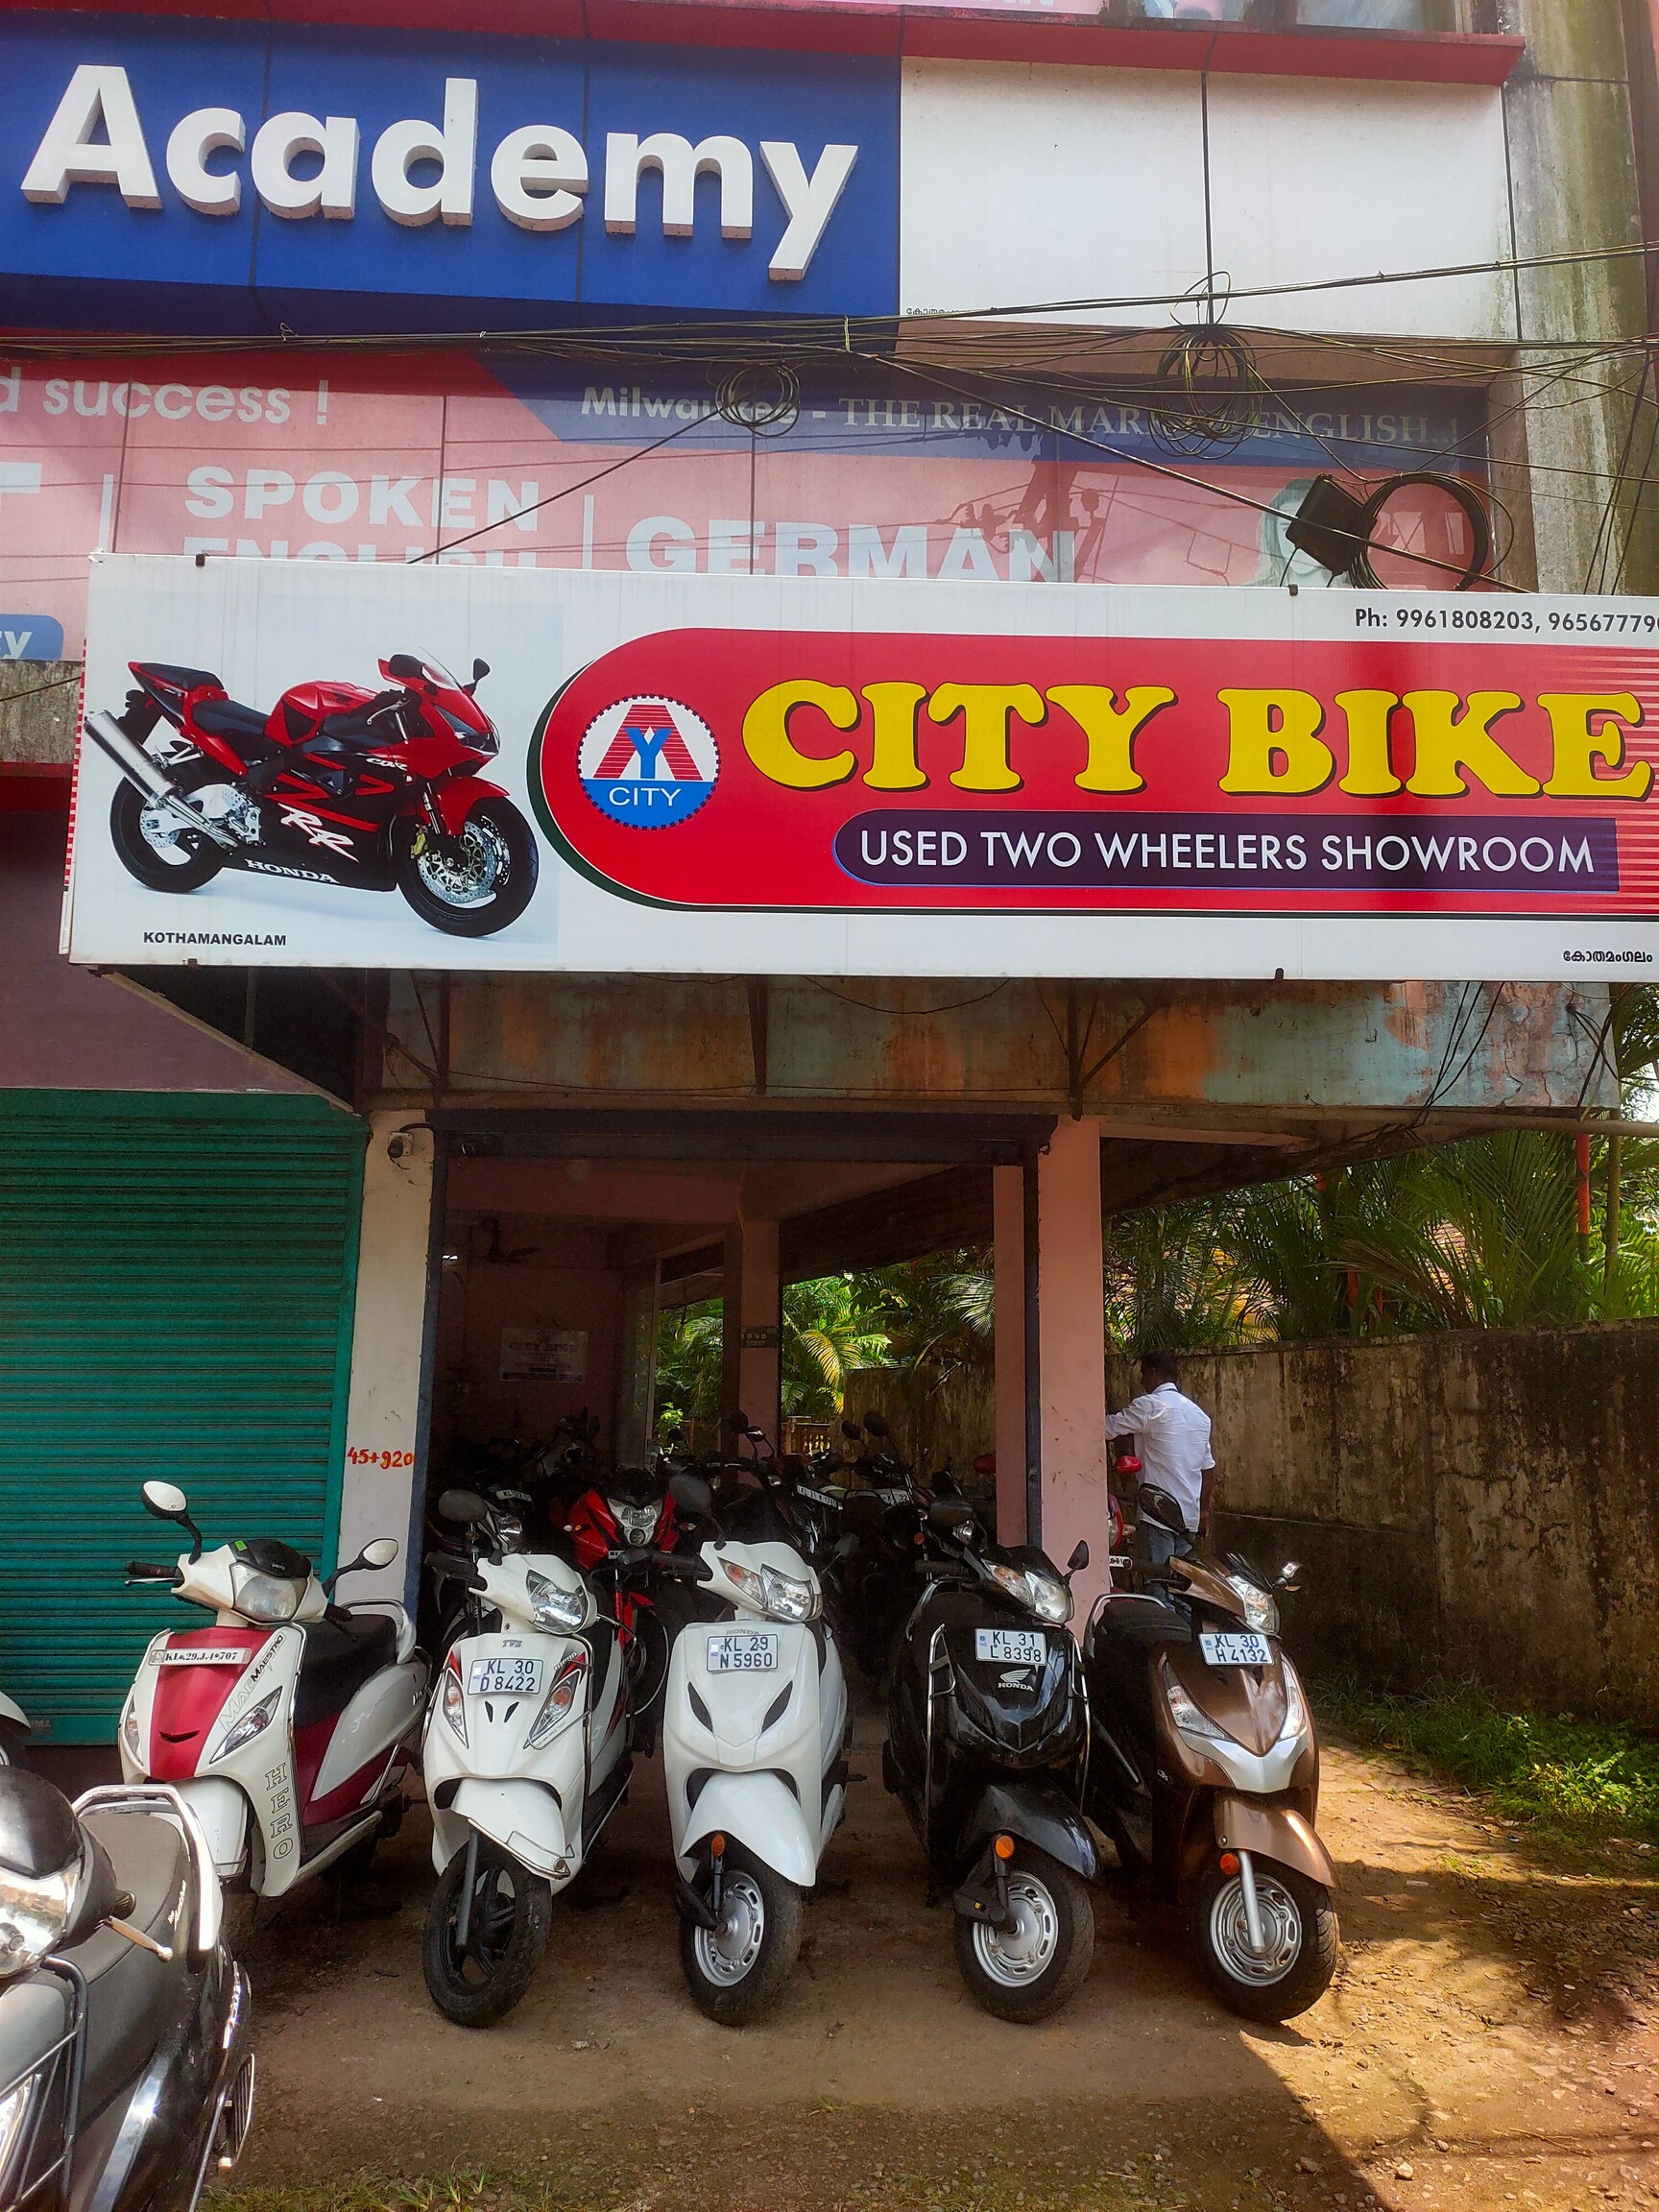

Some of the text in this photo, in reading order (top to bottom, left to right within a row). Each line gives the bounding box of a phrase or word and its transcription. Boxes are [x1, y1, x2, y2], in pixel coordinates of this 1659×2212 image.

[20, 64, 859, 281] Academy
[43, 377, 291, 424] success
[838, 397, 921, 428] THE
[931, 400, 1038, 433] REAL
[185, 466, 539, 533] SPOKEN
[626, 516, 1076, 583] GERMAN
[1356, 608, 1659, 634] Ph: 9961808203, 96567779
[742, 679, 1657, 803] CITY BIKE
[608, 786, 683, 807] CITY
[860, 829, 1596, 874] USED TWO WHEELERS SHOWROOM
[244, 858, 341, 884] HONDA
[143, 931, 287, 947] KOTHAMANGALAM
[1563, 950, 1653, 963] കോതമംഗലം
[502, 1639, 523, 1648] TVS
[724, 1636, 768, 1652] KL 29
[993, 1631, 1035, 1647] KL 31
[1214, 1634, 1260, 1648] KL 30
[250, 1634, 284, 1682] MAESTRO
[720, 1652, 772, 1669] N 5960
[990, 1645, 1042, 1663] L 8398
[1215, 1648, 1268, 1663] H 4132
[487, 1660, 534, 1674] KL 30
[494, 1676, 536, 1692] 8422
[998, 1682, 1035, 1693] HONDA
[265, 1762, 294, 1860] HERO
